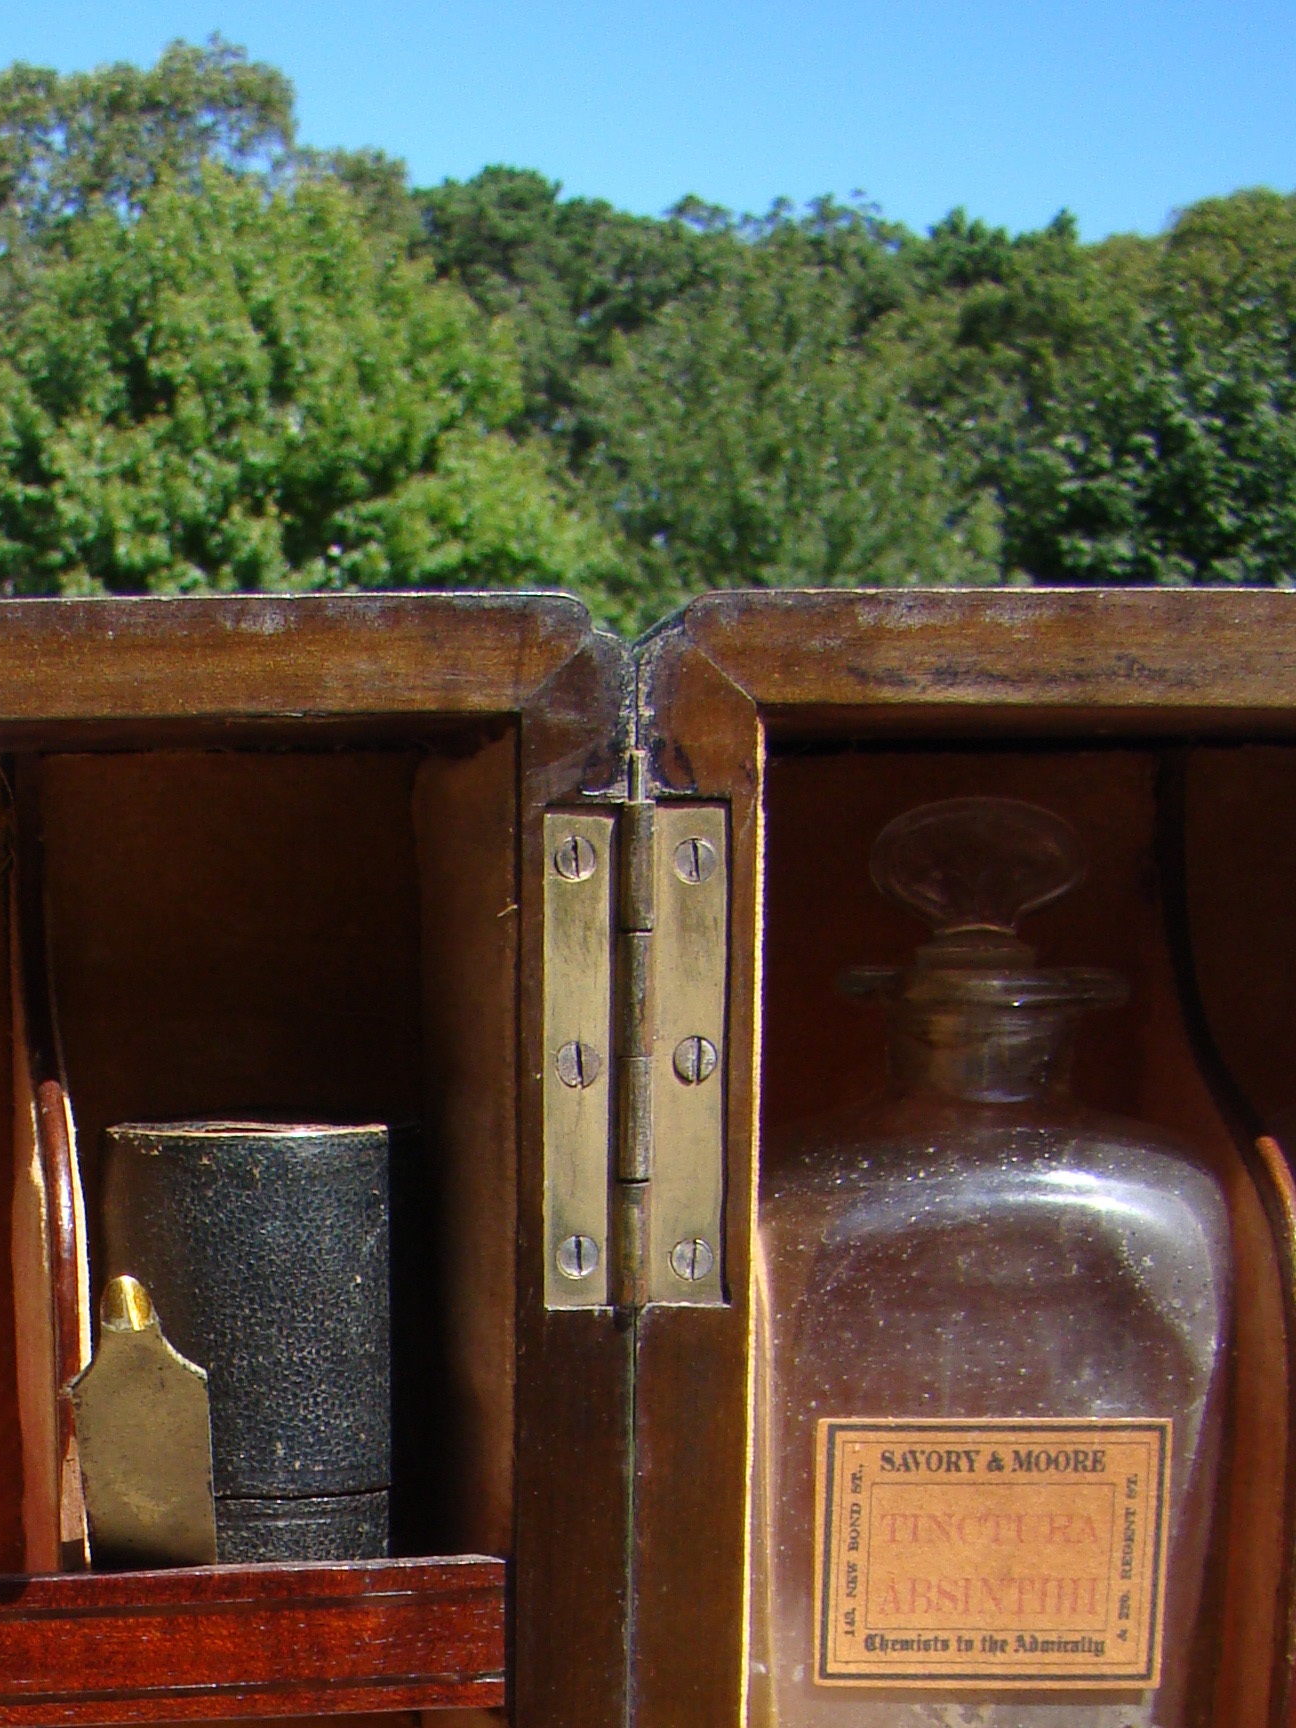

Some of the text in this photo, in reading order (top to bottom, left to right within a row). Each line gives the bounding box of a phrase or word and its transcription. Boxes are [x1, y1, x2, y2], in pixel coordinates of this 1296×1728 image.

[881, 1450, 1106, 1473] SAVORY & MOORE
[1126, 1473, 1138, 1499] ST.
[848, 1502, 861, 1552] BOND
[879, 1512, 1098, 1545] TINCTURA
[1121, 1506, 1137, 1580] REGENT
[846, 1561, 858, 1598] NEW
[864, 1633, 1105, 1656] Chemists to the Admiralty
